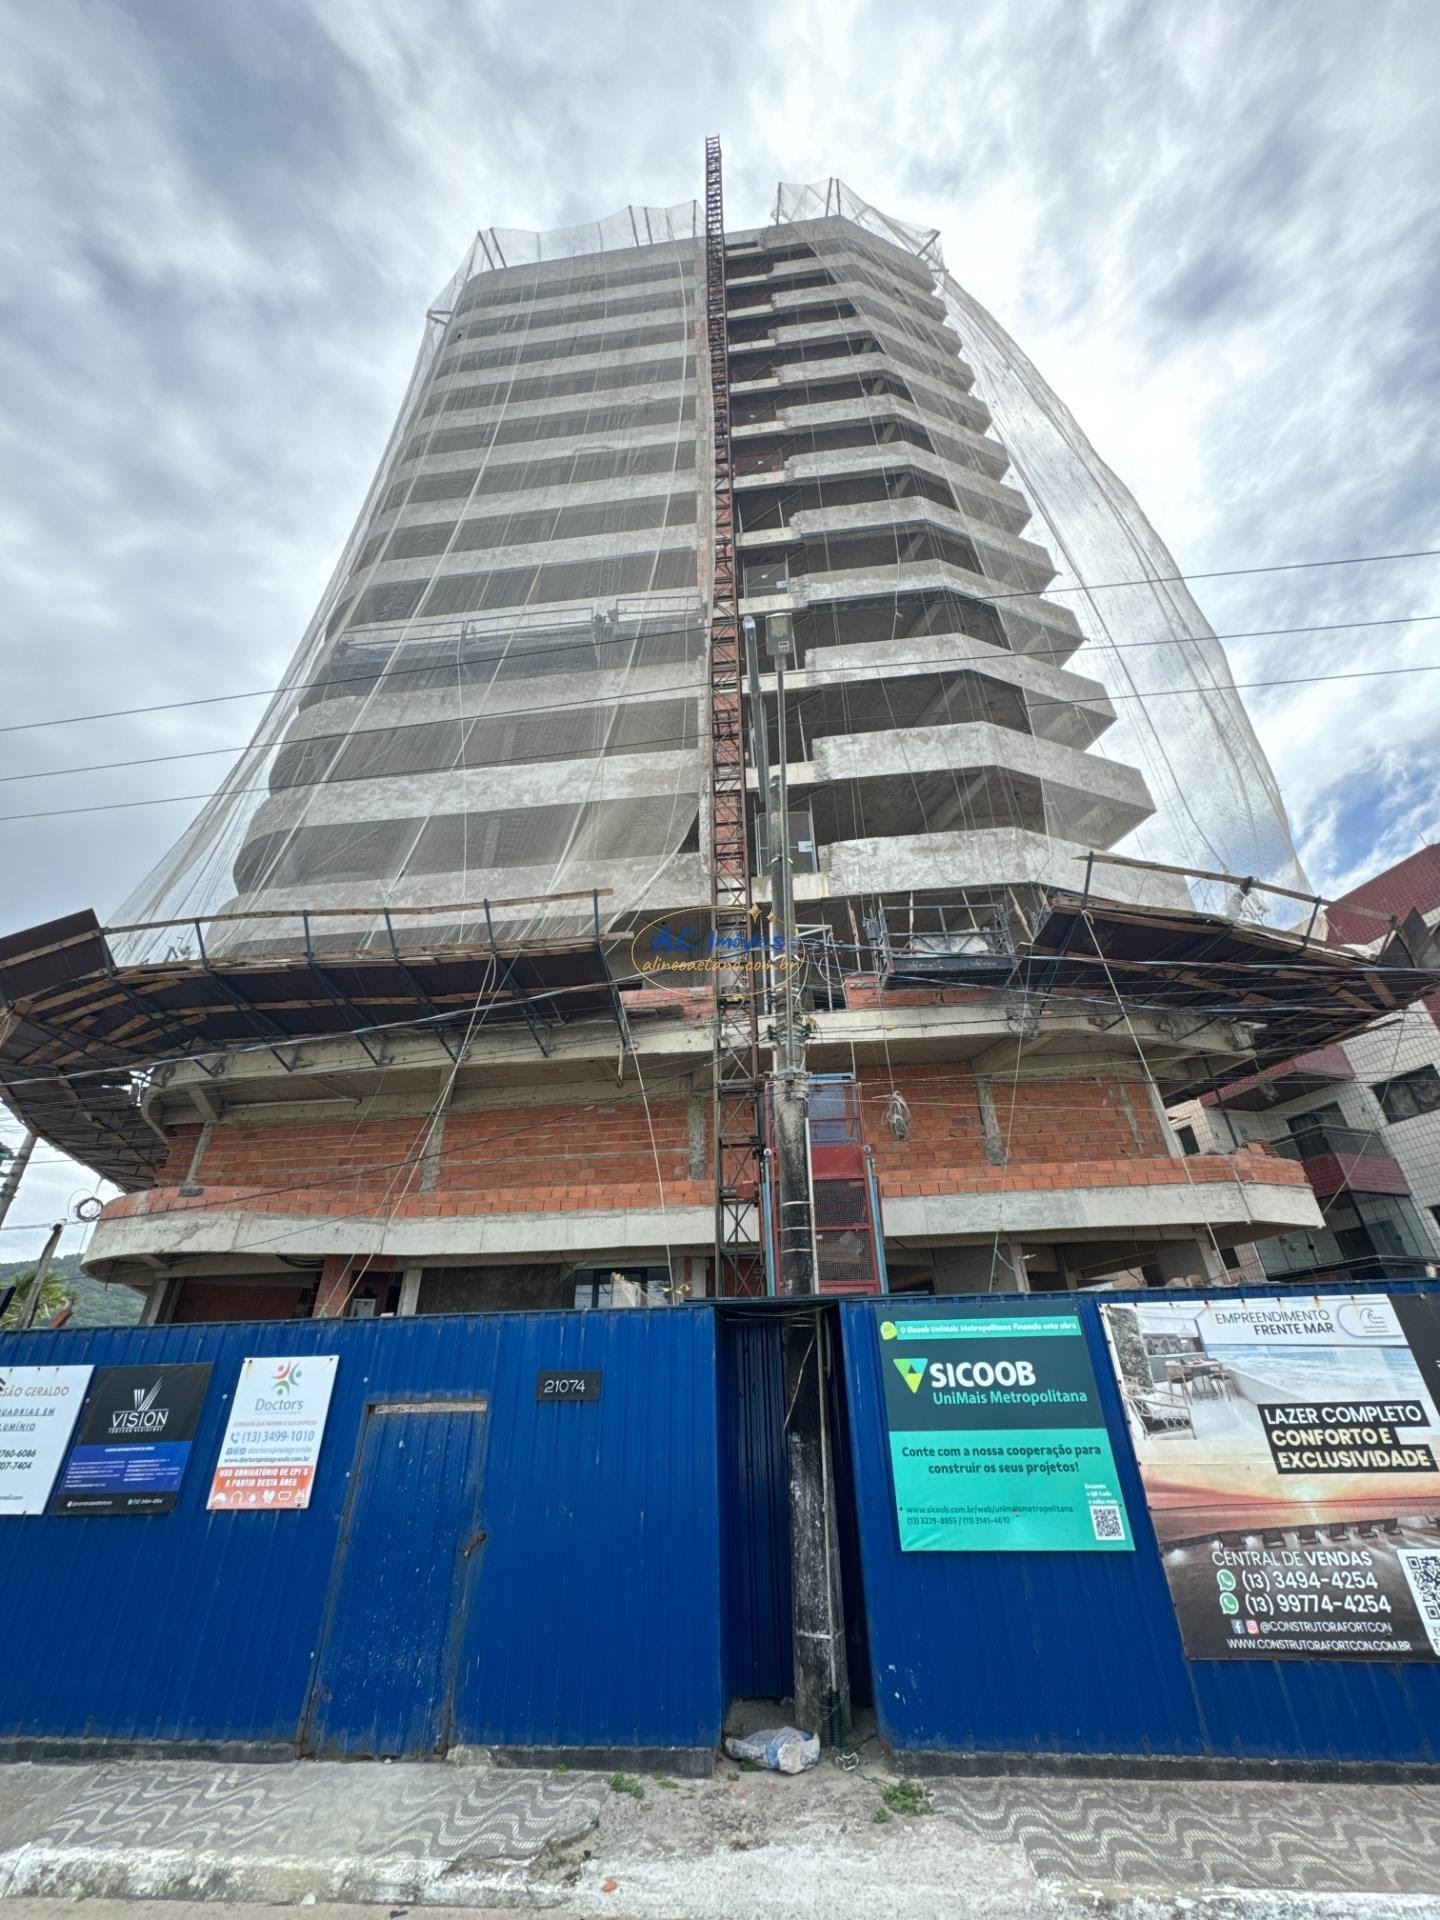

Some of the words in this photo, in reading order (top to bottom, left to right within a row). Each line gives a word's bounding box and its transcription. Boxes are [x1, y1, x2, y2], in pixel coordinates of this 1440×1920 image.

[1215, 1309, 1330, 1325] EMPREENDIMENTO
[1254, 1323, 1302, 1336] FRENTE
[1304, 1322, 1335, 1334] MAR
[929, 1361, 1036, 1388] SICOOB
[25, 1386, 69, 1397] GERALDO
[544, 1380, 586, 1393] 21074
[933, 1391, 988, 1404] UniMais
[990, 1389, 1088, 1406] Metropolitana
[0, 1408, 40, 1417] UADRIAS
[112, 1411, 169, 1427] VISION
[1264, 1406, 1318, 1426] LAZER
[1321, 1404, 1422, 1423] COMPLETO
[0, 1421, 36, 1432] UMÍNIO
[242, 1431, 261, 1443] (13)
[262, 1430, 315, 1442] 3499-1010
[1271, 1428, 1377, 1447] CONFORTO
[1379, 1428, 1393, 1444] E
[902, 1446, 935, 1457] Conte
[937, 1448, 961, 1456] com
[963, 1448, 970, 1456] a
[972, 1448, 1005, 1456] nossa
[1006, 1445, 1073, 1458] cooperação
[1075, 1446, 1101, 1457] para
[1278, 1449, 1431, 1469] EXCLUSIVIDADE
[928, 1462, 982, 1474] construir
[983, 1464, 996, 1473] os
[998, 1464, 1024, 1473] seus
[1026, 1461, 1080, 1476] projetos!
[1211, 1551, 1281, 1567] CENTRAL
[1284, 1551, 1302, 1566] DE
[1303, 1551, 1373, 1566] VENDAS
[1241, 1572, 1271, 1592] (13)
[1275, 1571, 1379, 1590] 3494-4254
[1245, 1595, 1275, 1616] (13)
[1276, 1594, 1392, 1613] 99774-4254
[1260, 1621, 1393, 1634] @CONSTRUTORAFORTCON
[1227, 1638, 1413, 1652] WWW.CONSTRUTORAFORTCON.COM.BR
